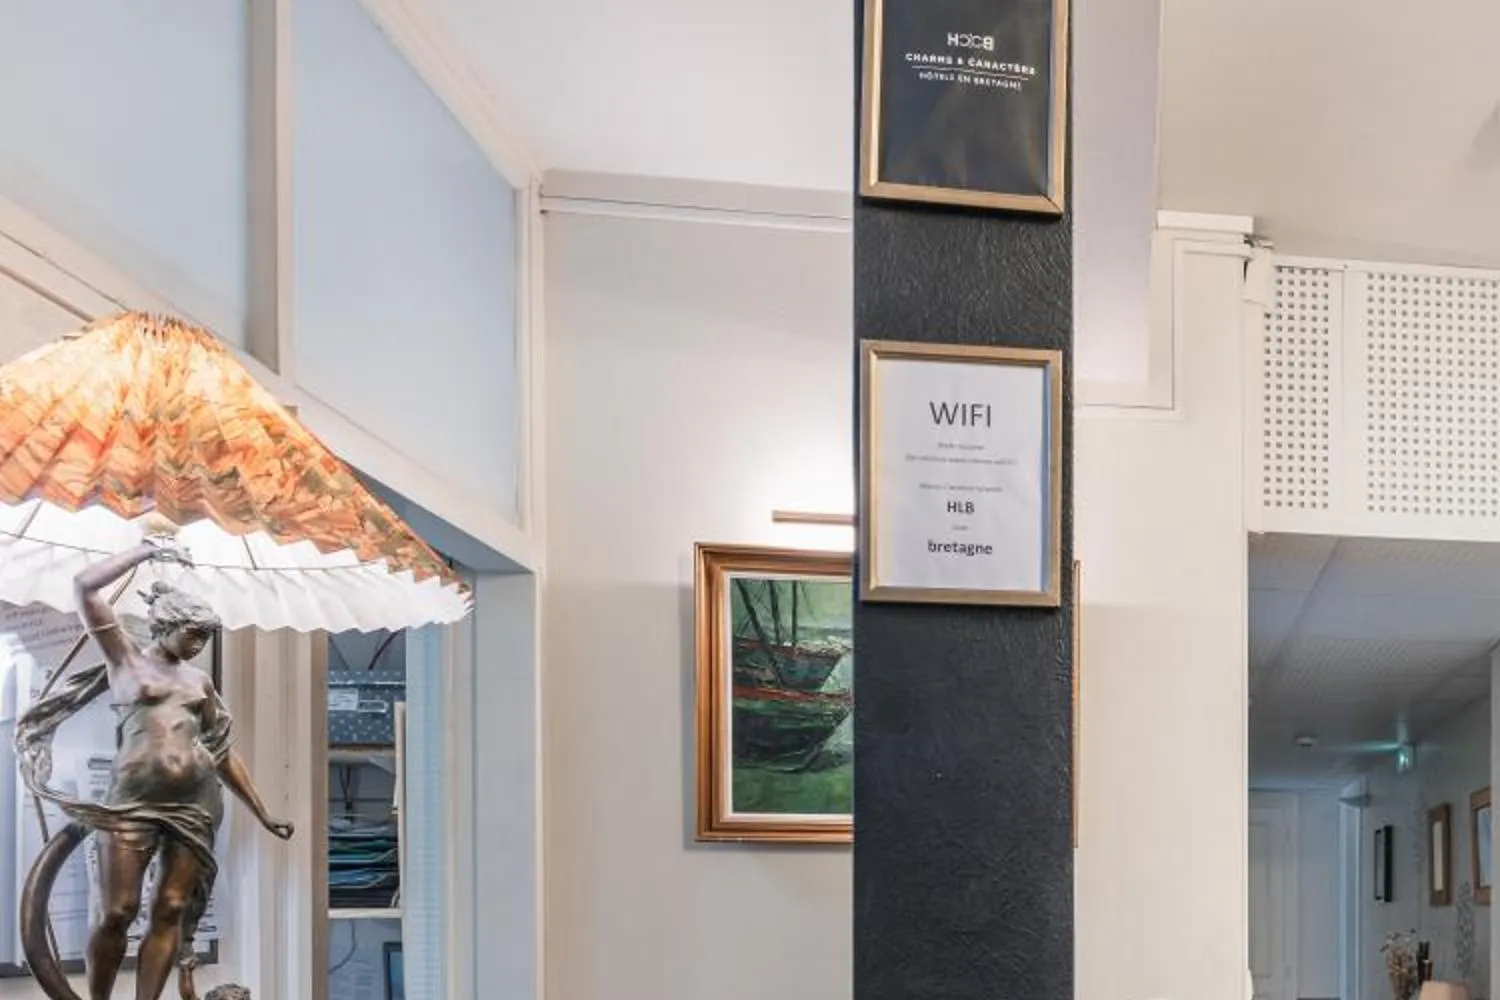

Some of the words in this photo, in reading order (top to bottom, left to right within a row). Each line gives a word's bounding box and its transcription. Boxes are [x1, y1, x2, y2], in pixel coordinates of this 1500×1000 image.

[928, 400, 992, 428] WIFI
[946, 500, 976, 515] HLB
[927, 539, 993, 557] bretagne
